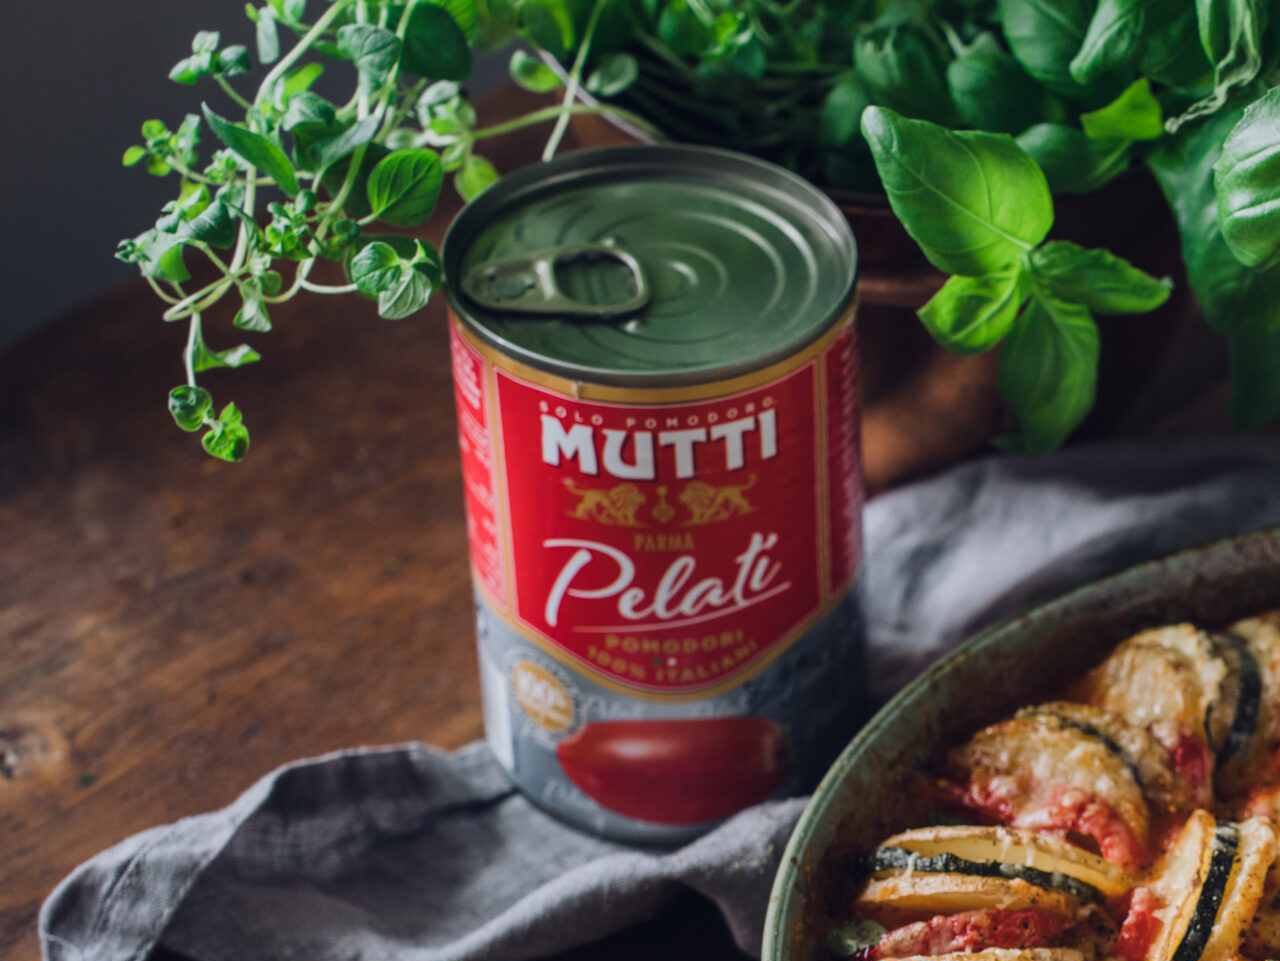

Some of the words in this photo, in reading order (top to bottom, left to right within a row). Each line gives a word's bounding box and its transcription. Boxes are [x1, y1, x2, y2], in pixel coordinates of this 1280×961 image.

[538, 400, 604, 426] SOLO
[625, 396, 775, 429] POMODORO
[540, 408, 777, 480] MUTTI
[633, 533, 695, 551] PARMA
[542, 532, 782, 628] Pelati
[604, 629, 745, 655] POMODORI
